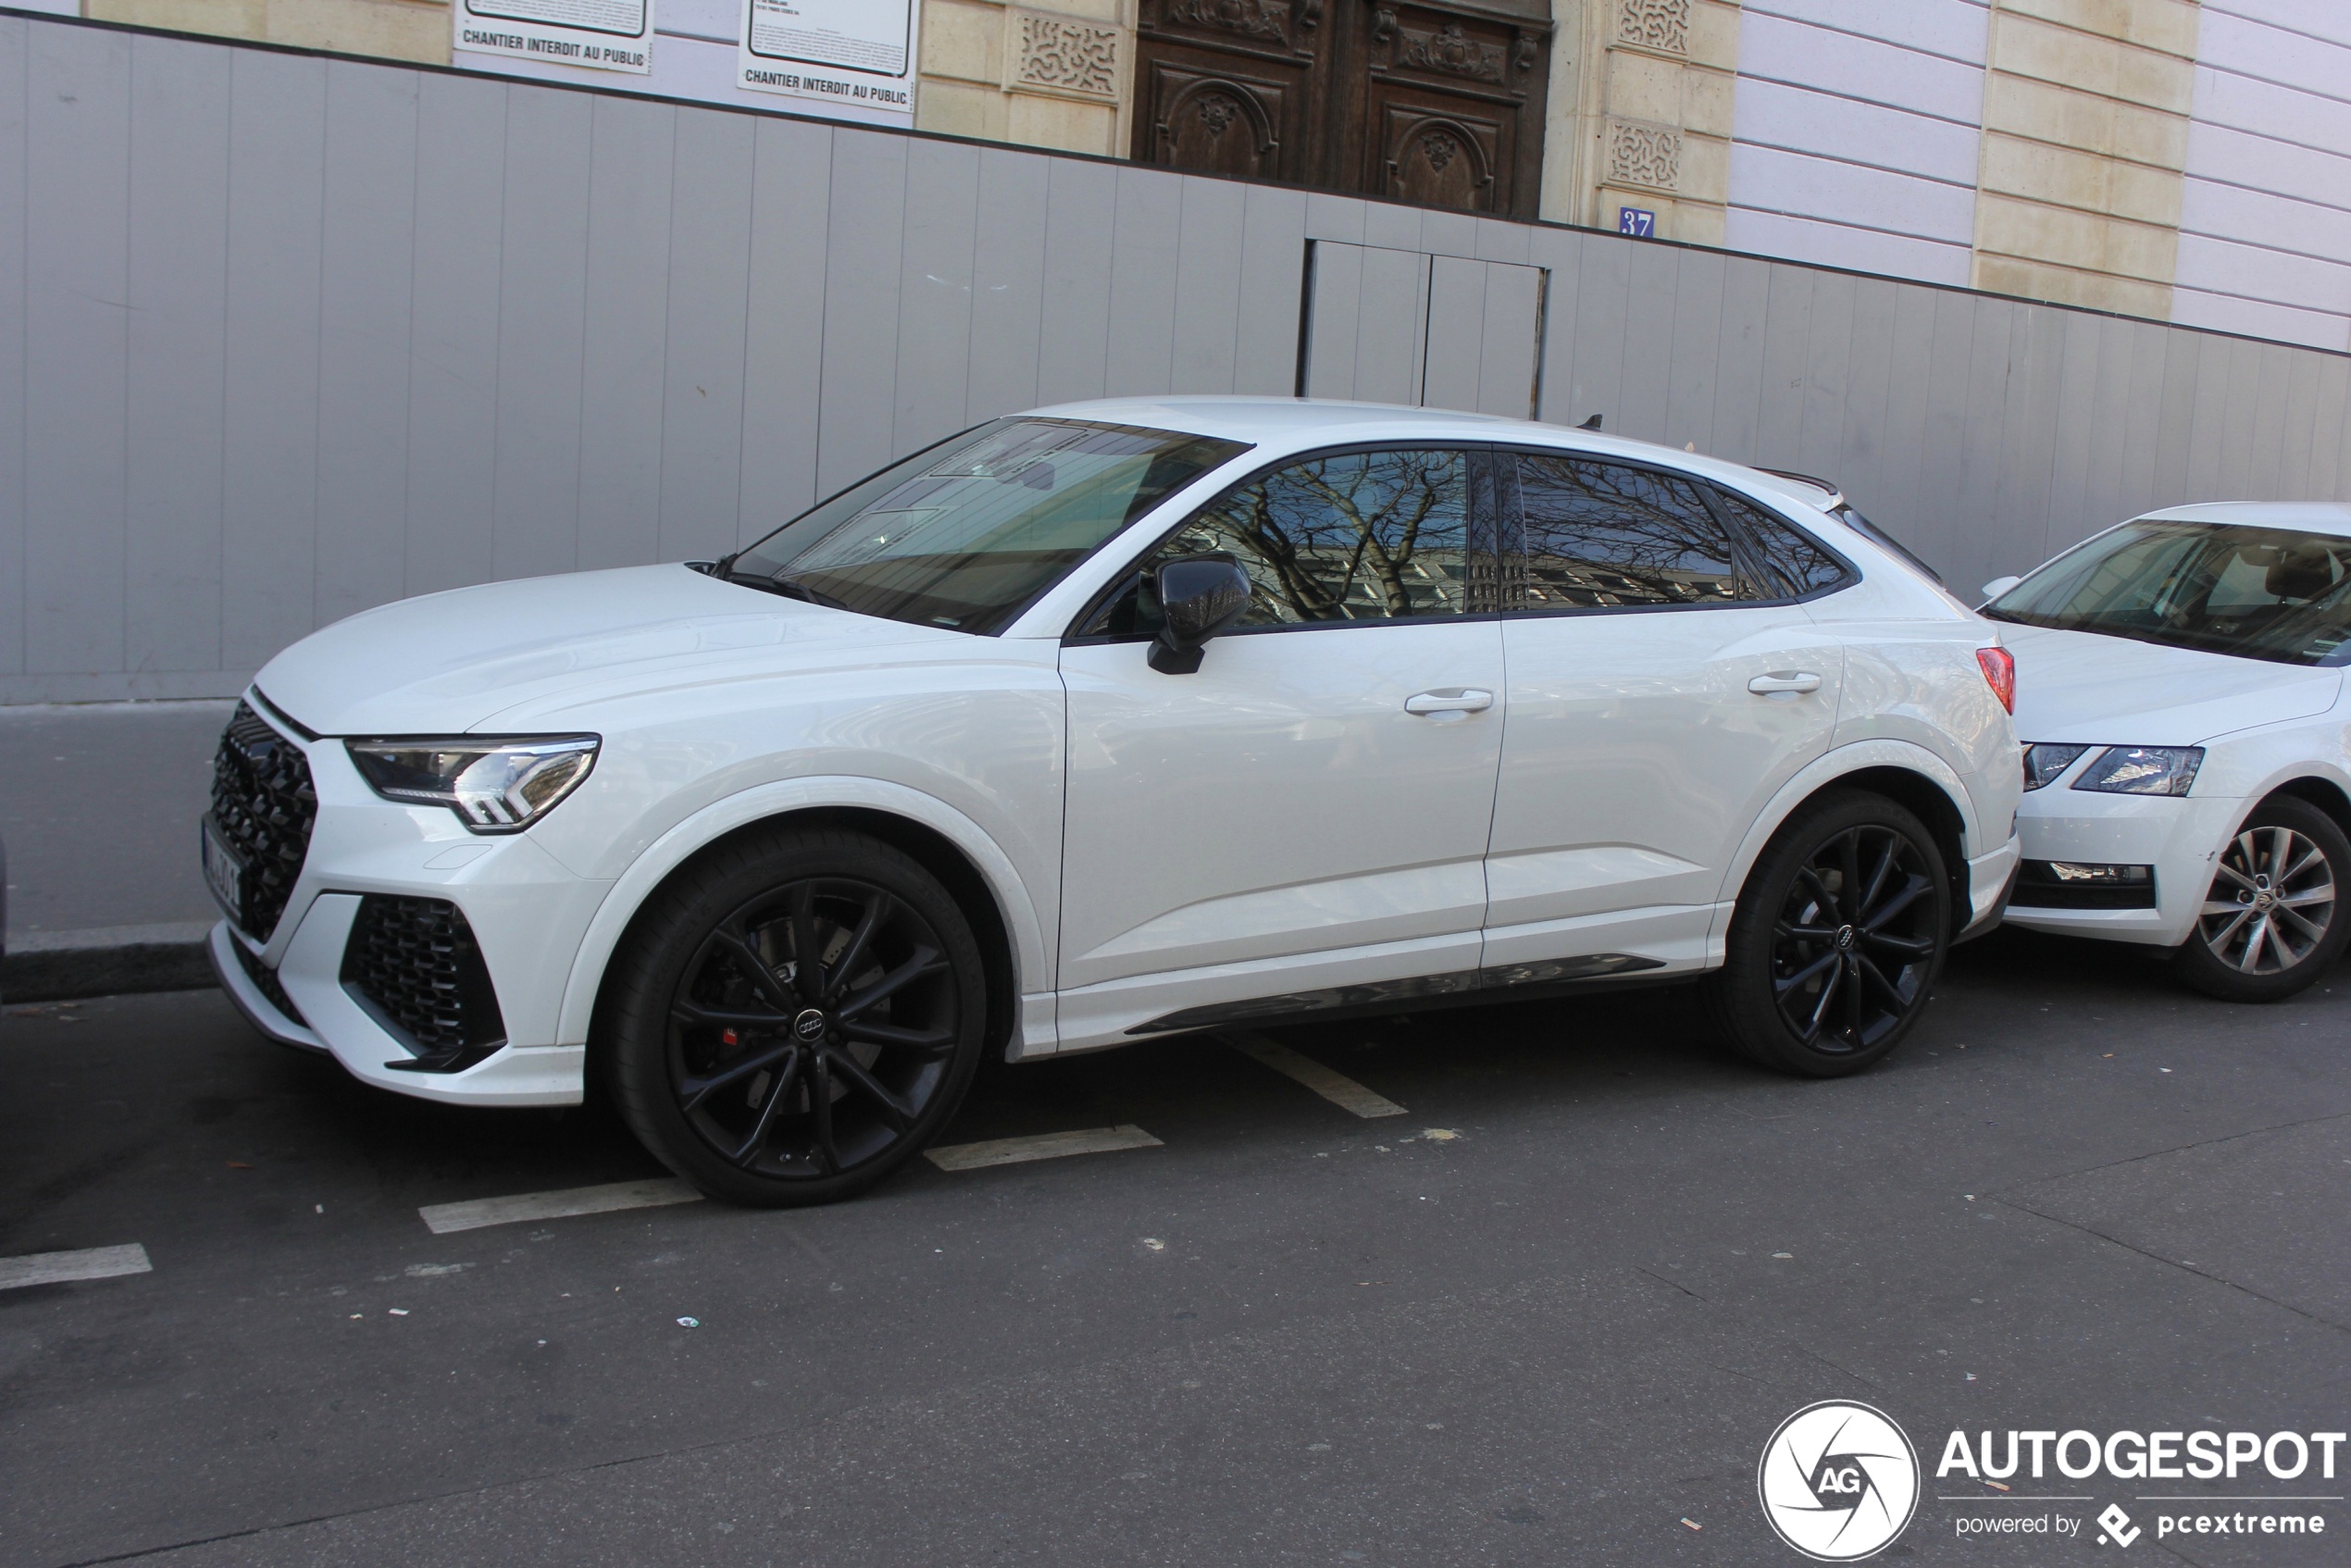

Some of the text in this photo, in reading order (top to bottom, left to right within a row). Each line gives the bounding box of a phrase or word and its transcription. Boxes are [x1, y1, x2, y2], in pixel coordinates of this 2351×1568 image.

[463, 29, 524, 50] CHANTIER
[527, 37, 580, 58] INTERDIT
[583, 45, 600, 60] AU
[603, 48, 644, 67] PUBLIC
[745, 69, 800, 89] CHANTIER
[802, 77, 851, 96] INTERDIT
[852, 84, 867, 98] AU
[870, 88, 907, 105] PUBLIC
[1622, 210, 1652, 237] 37
